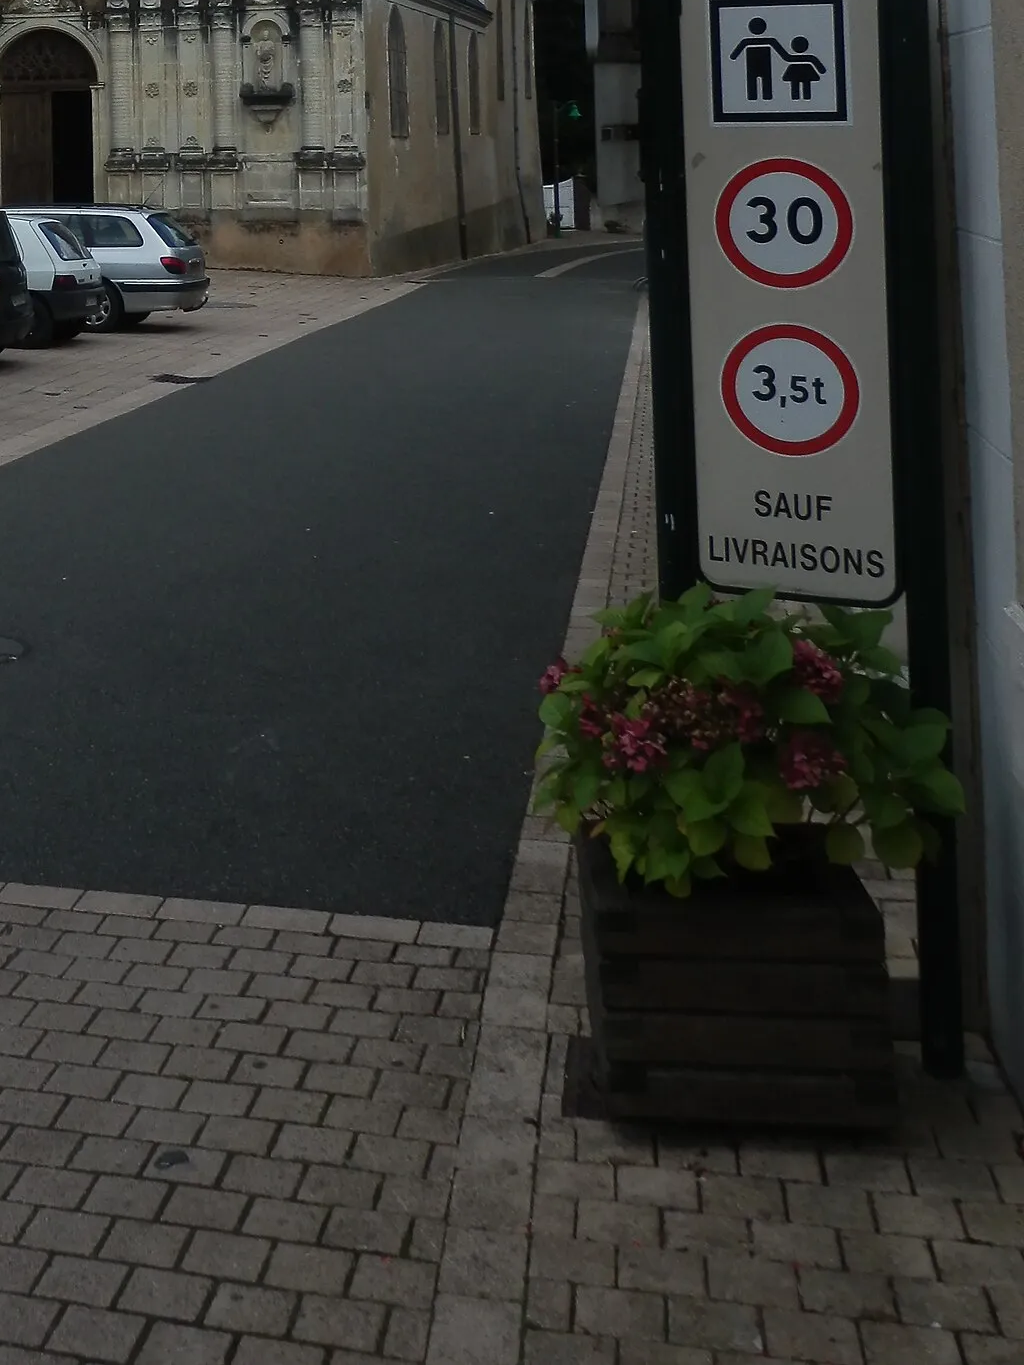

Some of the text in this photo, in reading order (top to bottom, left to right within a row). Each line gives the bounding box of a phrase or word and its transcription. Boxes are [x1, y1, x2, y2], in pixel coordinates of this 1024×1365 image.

[746, 196, 824, 245] 30
[751, 364, 828, 409] 3,5t
[754, 490, 832, 522] SAUF
[708, 535, 885, 578] LIVRAISONS
